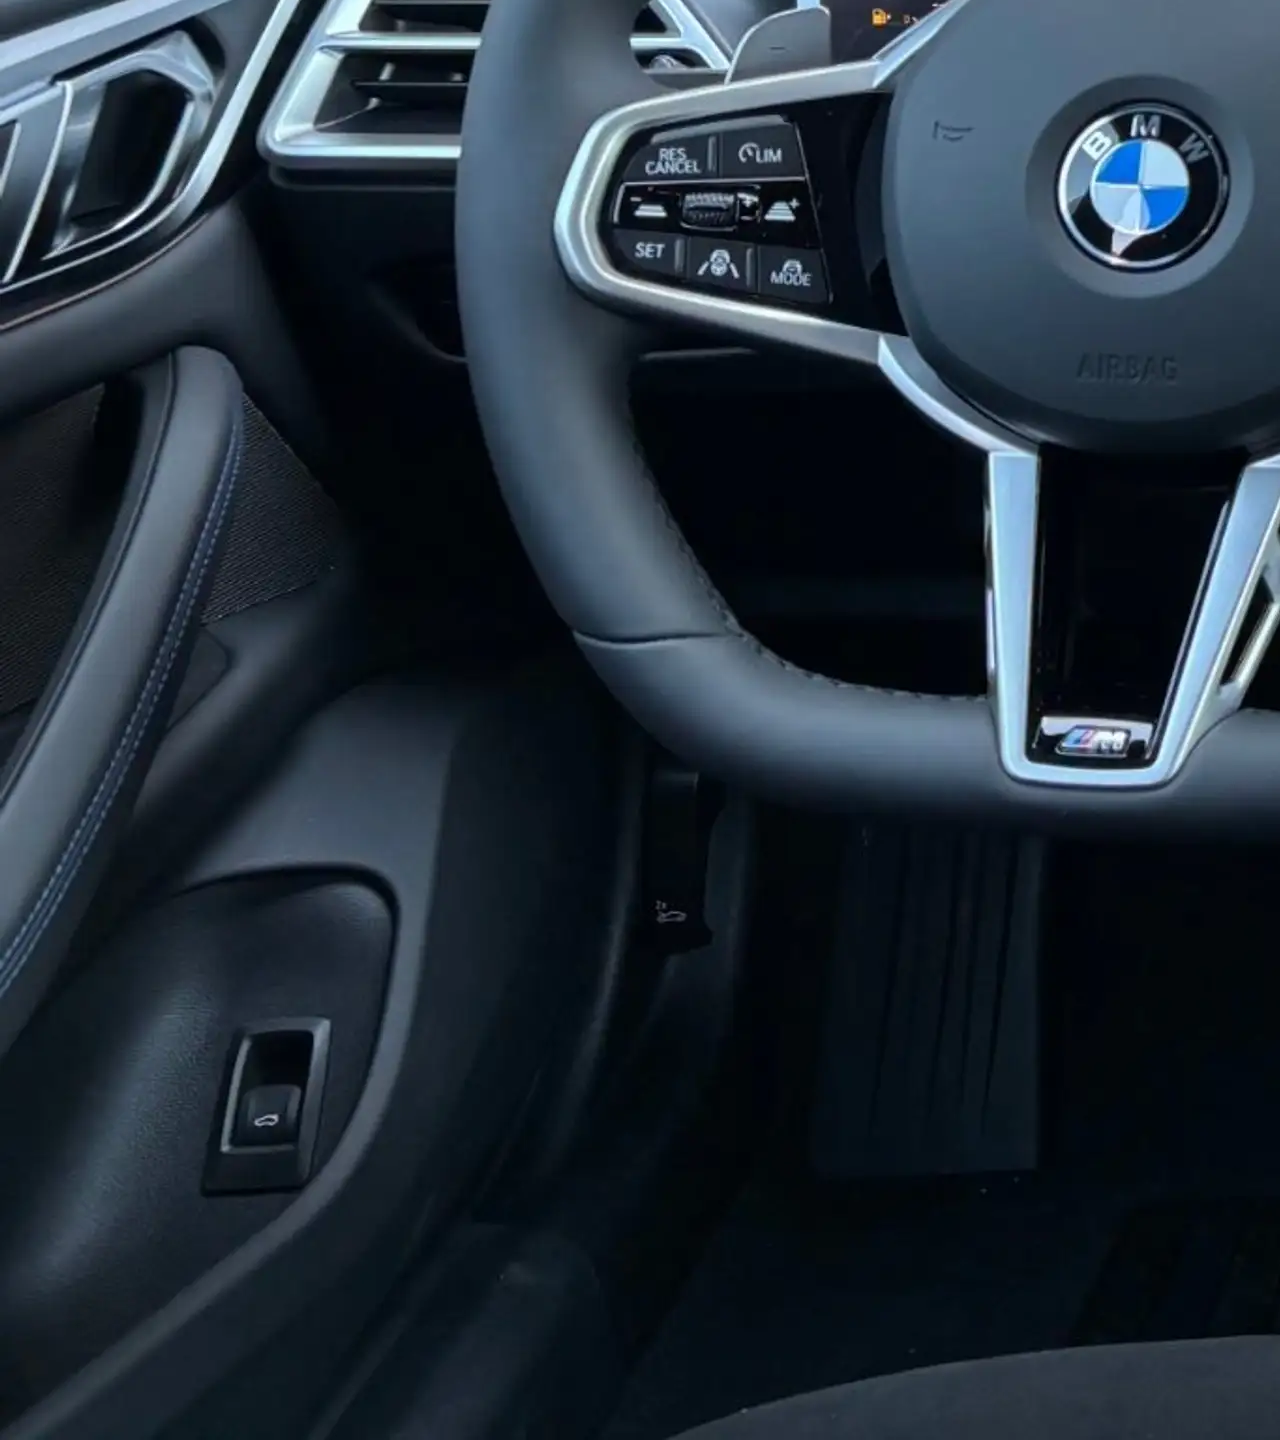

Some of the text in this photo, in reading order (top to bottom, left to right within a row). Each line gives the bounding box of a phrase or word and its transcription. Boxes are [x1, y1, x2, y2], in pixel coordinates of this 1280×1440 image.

[1082, 114, 1210, 165] BMW
[659, 147, 687, 161] RES
[755, 148, 782, 163] LIM
[645, 160, 701, 175] CANCEL
[635, 242, 665, 258] SET
[770, 271, 812, 287] MODE
[1076, 351, 1178, 382] AIRBAG
